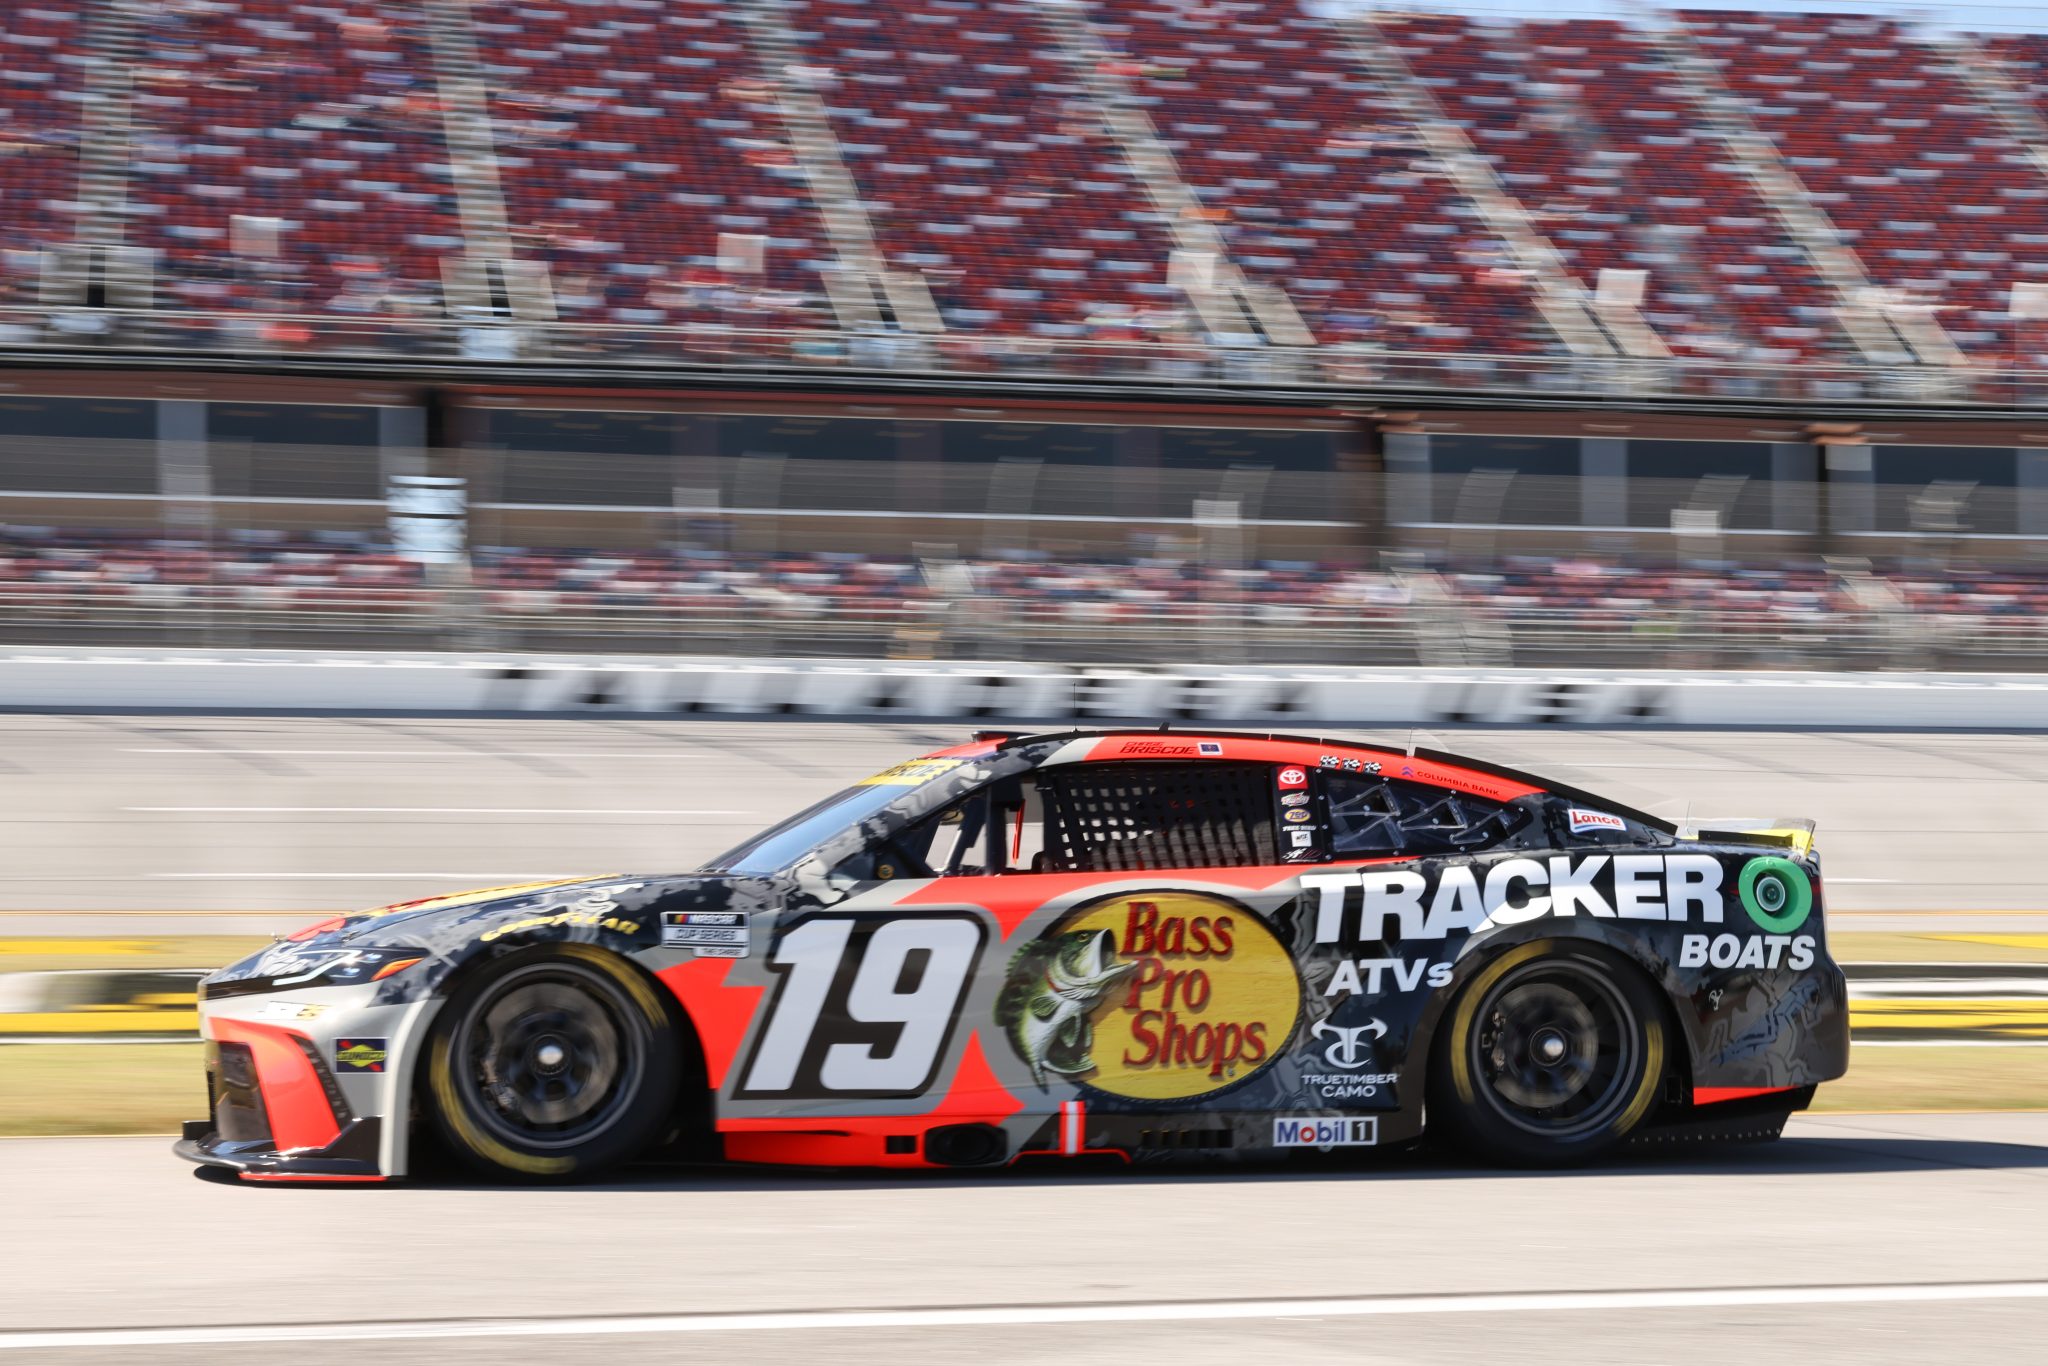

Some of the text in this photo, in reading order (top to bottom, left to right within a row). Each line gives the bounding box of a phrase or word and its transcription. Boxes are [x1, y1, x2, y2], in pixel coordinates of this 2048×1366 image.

[1120, 746, 1197, 755] BRISCOE
[1416, 771, 1500, 796] COLUMBIA BANK
[1572, 811, 1621, 826] Lance
[1300, 854, 1723, 944] TRACKER
[674, 928, 736, 940] CUP SERIES
[1120, 900, 1235, 957] Bass
[1679, 934, 1816, 971] BOATS
[1123, 957, 1210, 1011] Pro
[1324, 957, 1455, 997] ATVs
[743, 919, 980, 1091] 19
[1122, 1010, 1267, 1080] Shops
[1301, 1073, 1398, 1085] TRUETIMBER
[1321, 1085, 1377, 1098] CAMO
[1277, 1121, 1366, 1143] Mobil 1
